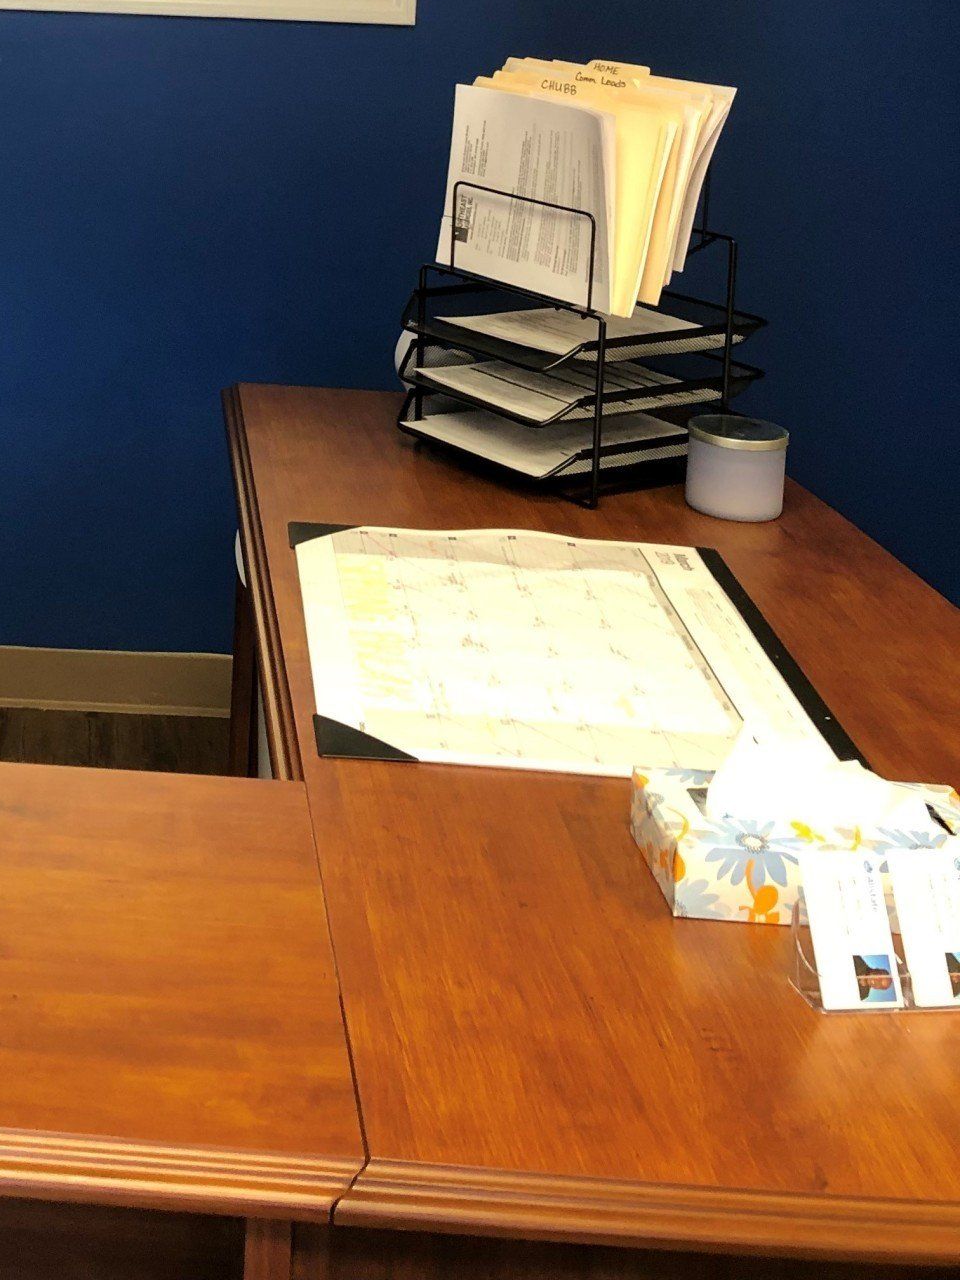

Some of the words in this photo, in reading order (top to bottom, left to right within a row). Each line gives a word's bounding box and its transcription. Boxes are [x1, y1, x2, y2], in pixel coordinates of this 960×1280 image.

[593, 62, 620, 75] HOME
[541, 79, 578, 96] CHUBB
[575, 71, 597, 84] Comm
[601, 76, 627, 88] Leads
